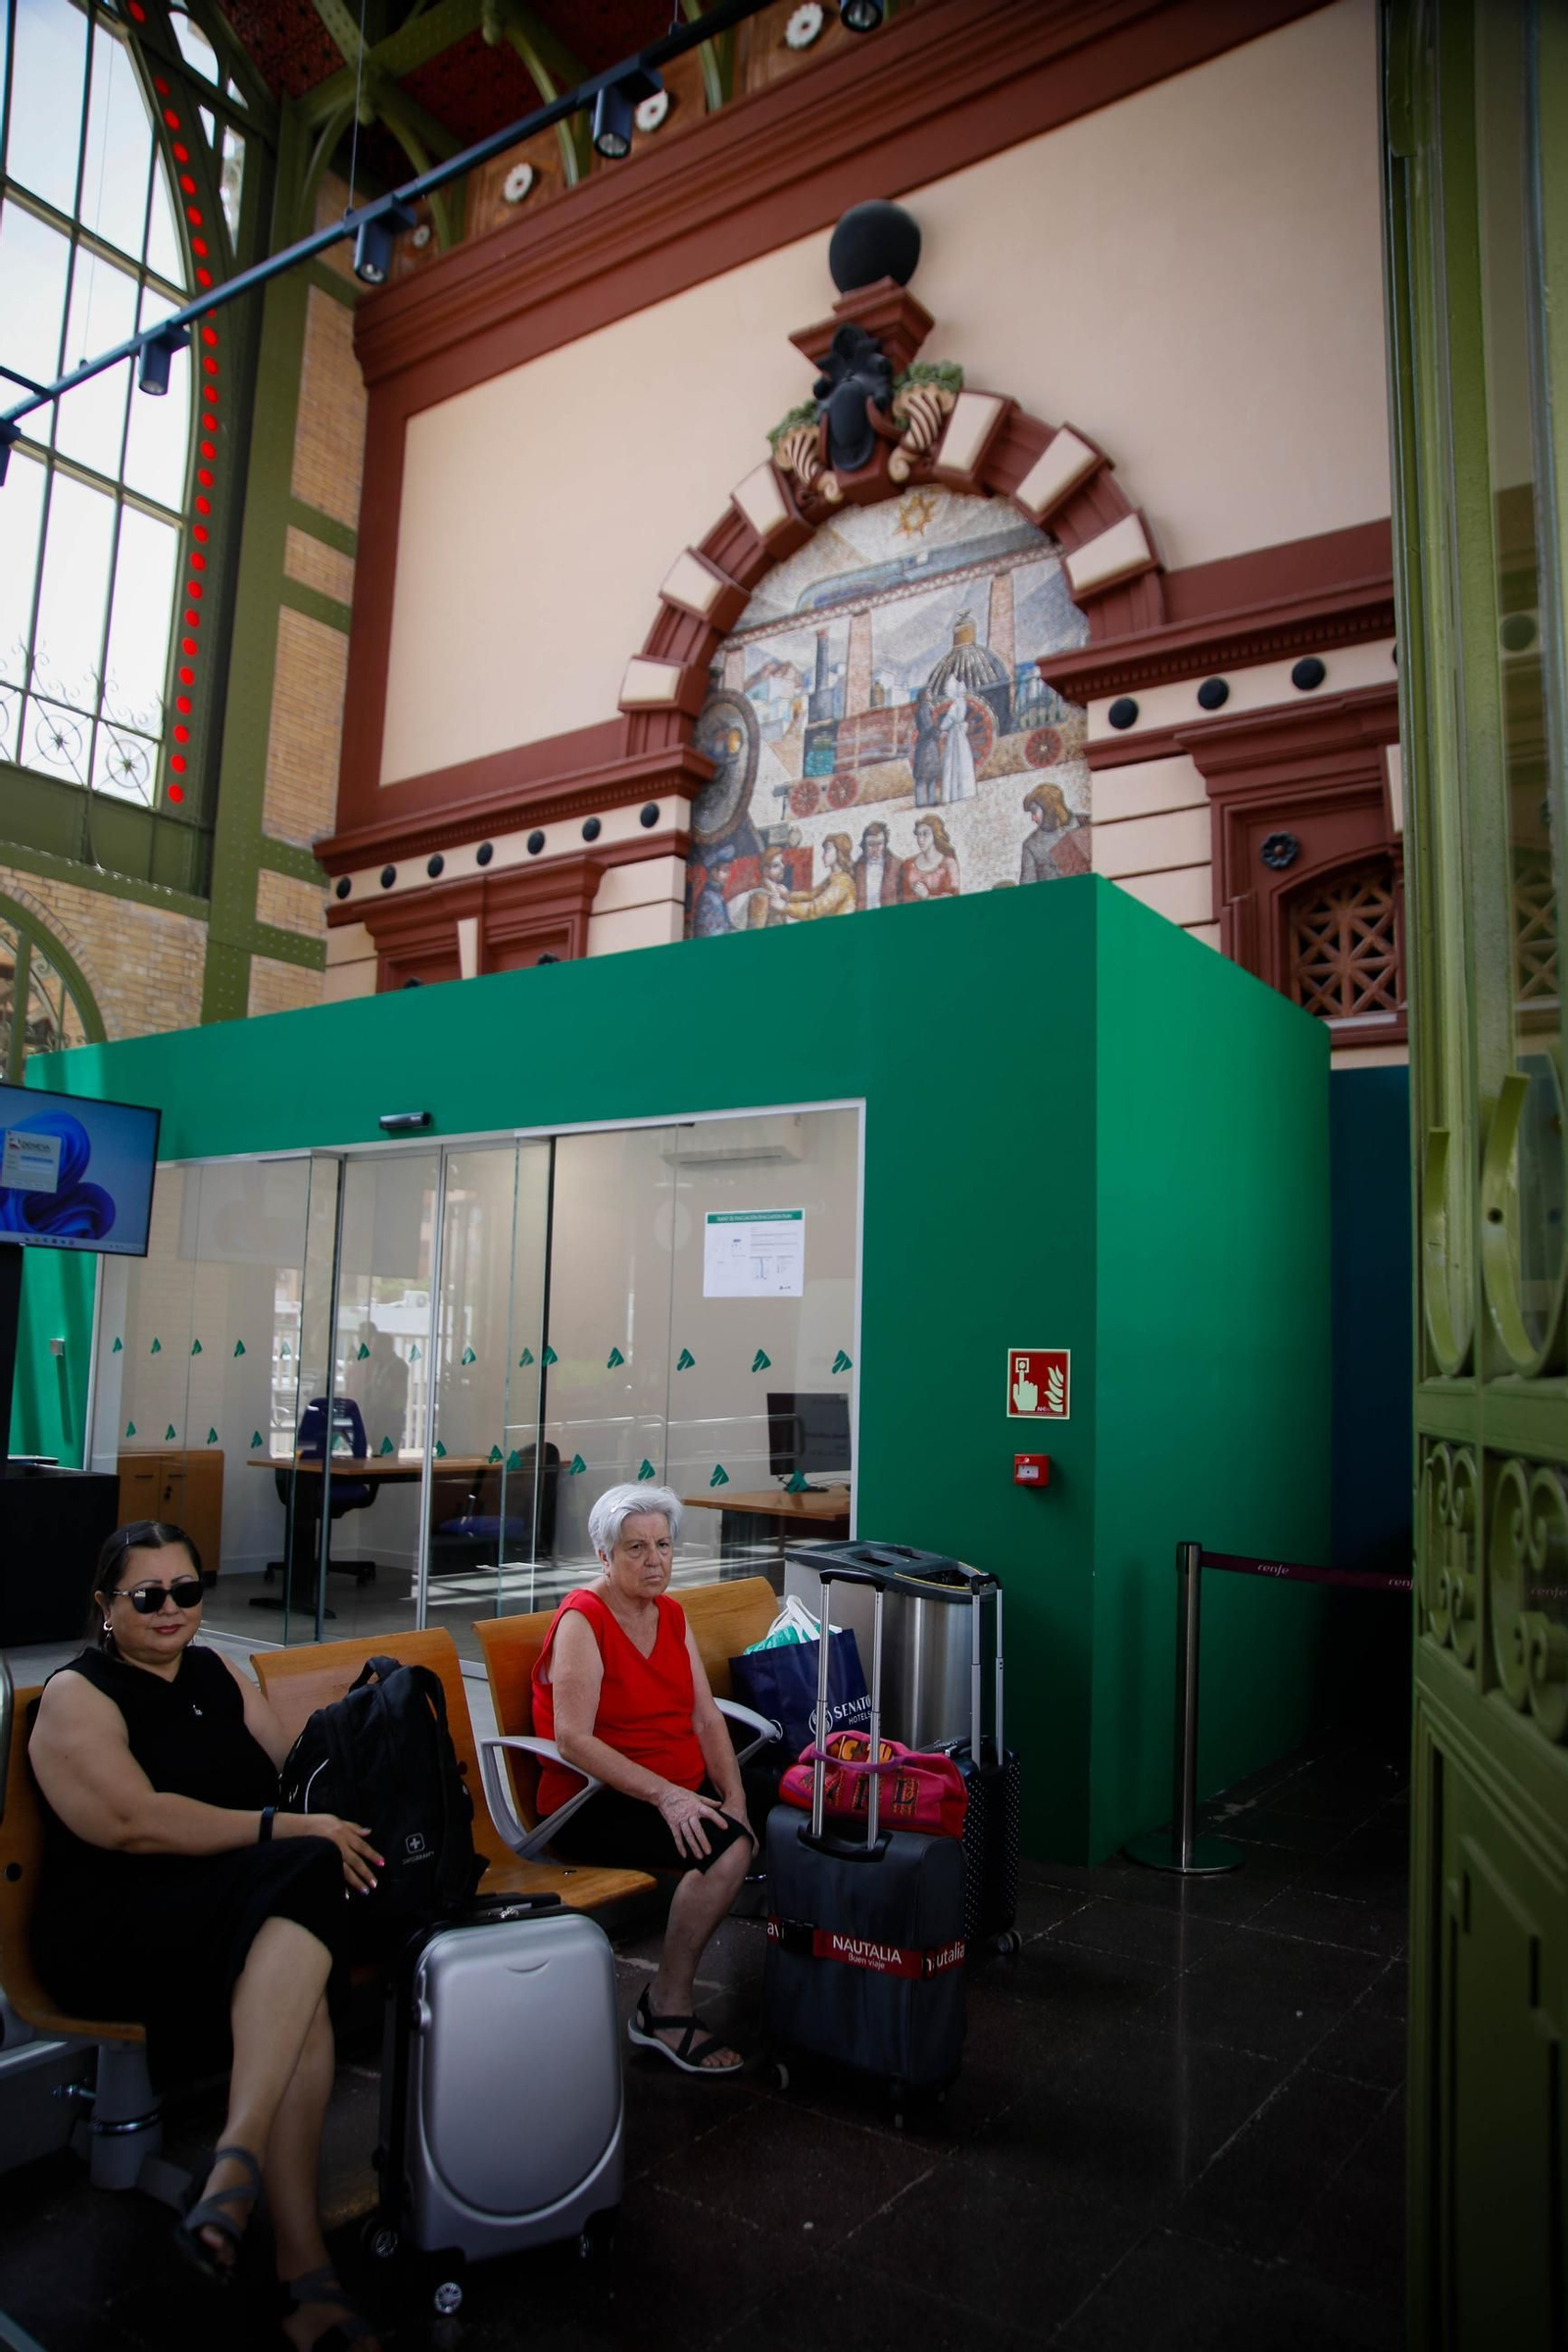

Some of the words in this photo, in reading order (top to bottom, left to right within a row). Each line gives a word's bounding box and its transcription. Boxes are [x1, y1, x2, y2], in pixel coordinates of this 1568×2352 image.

[1257, 1563, 1290, 1577] renfe
[833, 1693, 872, 1719] SENATO
[848, 1710, 872, 1726] HOTELS
[832, 1934, 903, 1965] NAUTALIA
[848, 1951, 867, 1965] Buen
[867, 1956, 886, 1971] viaje
